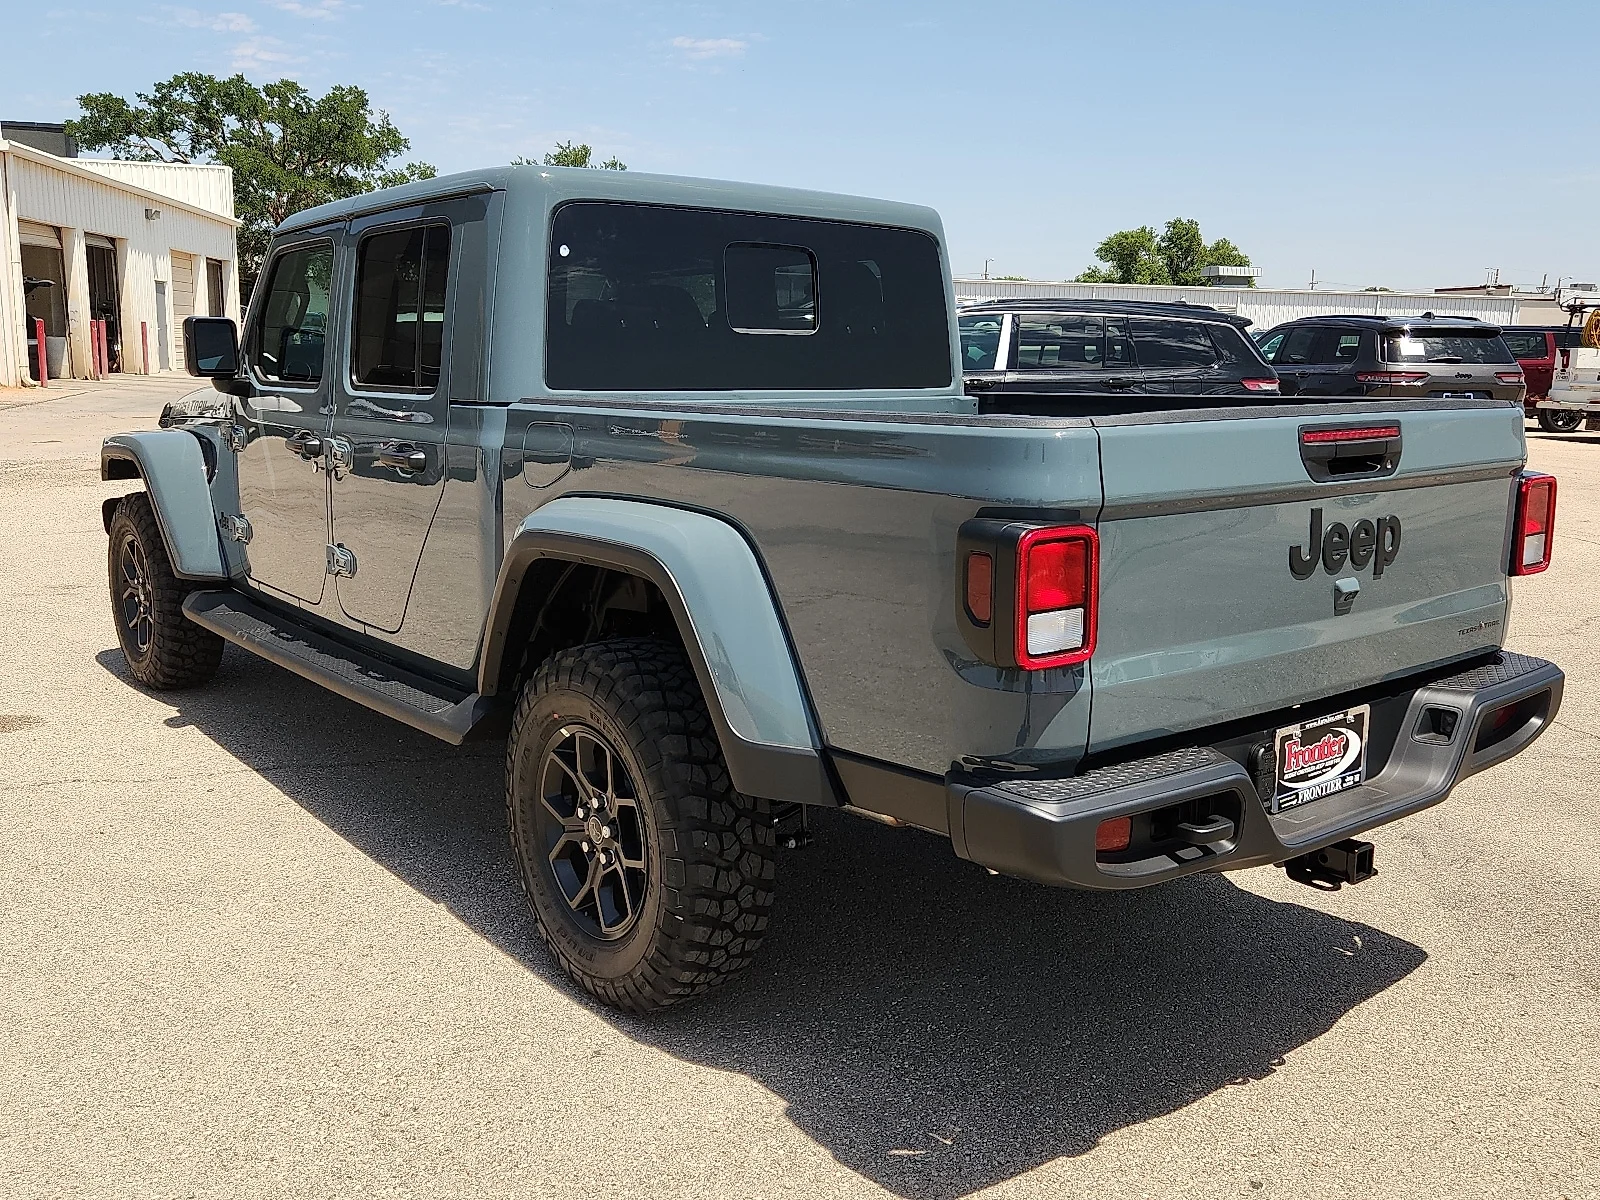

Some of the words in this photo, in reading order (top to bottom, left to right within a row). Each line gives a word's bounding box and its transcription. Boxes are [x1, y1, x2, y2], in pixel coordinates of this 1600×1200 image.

[1289, 507, 1401, 580] Jeep
[1285, 734, 1345, 772] Frontier
[1297, 777, 1342, 804] FRONTIER
